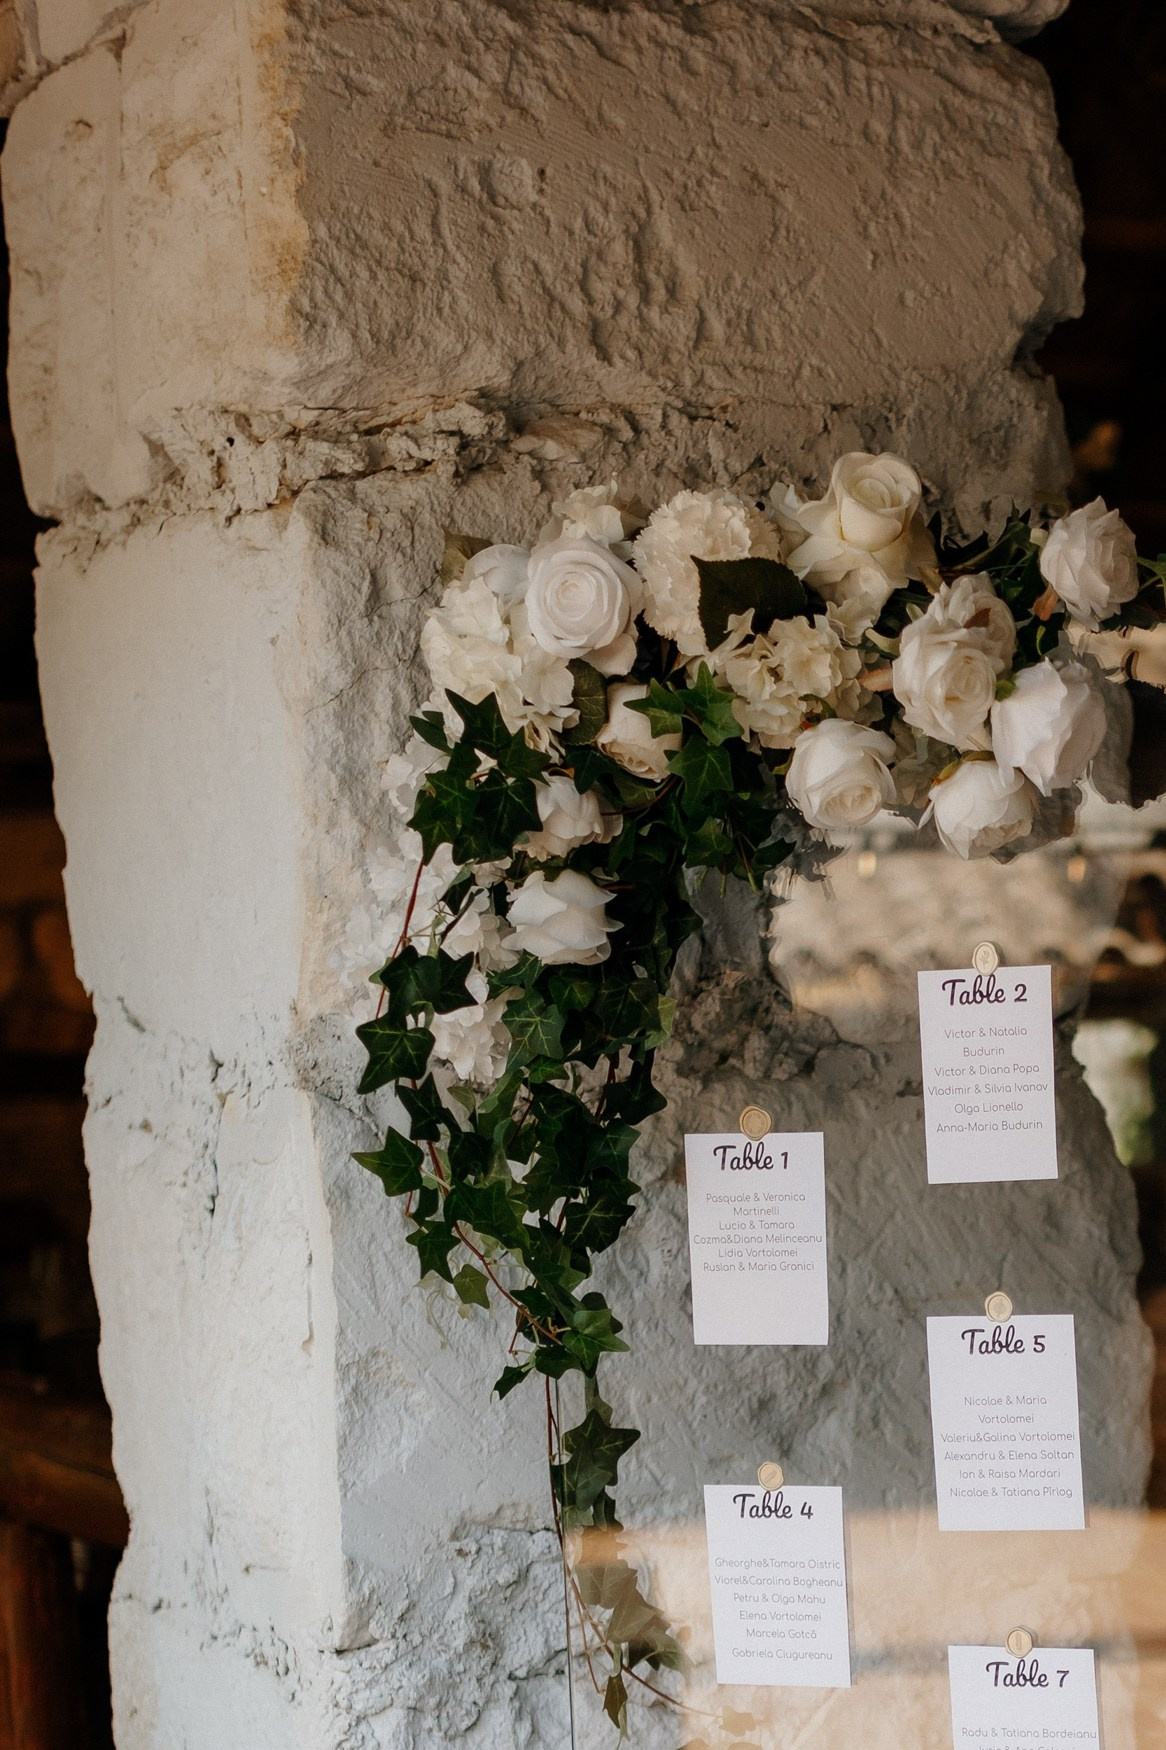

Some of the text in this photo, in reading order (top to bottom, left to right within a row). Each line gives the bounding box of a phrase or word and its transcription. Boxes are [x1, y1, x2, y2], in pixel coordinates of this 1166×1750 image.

[941, 973, 1028, 1006] Table 2
[944, 1026, 1028, 1039] Victor & Natalia
[963, 1046, 1005, 1057] Budurin
[934, 1067, 966, 1077] Victor
[969, 1065, 976, 1075] &
[979, 1065, 1010, 1075] Diana
[927, 1083, 1048, 1096] Vladimir & Silvia Ivanov
[954, 1102, 1024, 1116] Olga Lionello
[936, 1120, 1043, 1133] Anna-Maria Budurin
[713, 1141, 789, 1171] Table 1
[706, 1192, 806, 1205] Pasquale & Veronica
[733, 1206, 780, 1217] Martinelli
[749, 1220, 756, 1230] &
[758, 1219, 795, 1230] Tamara
[765, 1233, 823, 1244] Melinceanu
[718, 1248, 743, 1259] Lidia
[703, 1261, 815, 1272] Ruslan & Maria Granici
[961, 1324, 1046, 1356] Table 5
[964, 1395, 1047, 1406] Nicolae & Maria
[944, 1450, 996, 1461] Alexandru
[998, 1450, 1006, 1460] &
[1008, 1450, 1038, 1460] Elena
[959, 1469, 976, 1479] Ion
[978, 1469, 986, 1479] &
[988, 1469, 1016, 1479] Raisa
[950, 1488, 989, 1497] Nicolae
[991, 1487, 999, 1497] &
[1001, 1487, 1040, 1497] Tatiana
[732, 1490, 814, 1520] Table 4
[733, 1593, 759, 1603] Petru
[762, 1593, 769, 1603] &
[771, 1594, 795, 1605] Olga
[739, 1611, 767, 1620] Elena
[746, 1628, 786, 1639] Marcela
[732, 1648, 774, 1659] Gabriela
[985, 1658, 1070, 1688] Table 7
[961, 1727, 988, 1737] Radu
[991, 1728, 999, 1737] &
[1001, 1728, 1040, 1738] Tatiana
